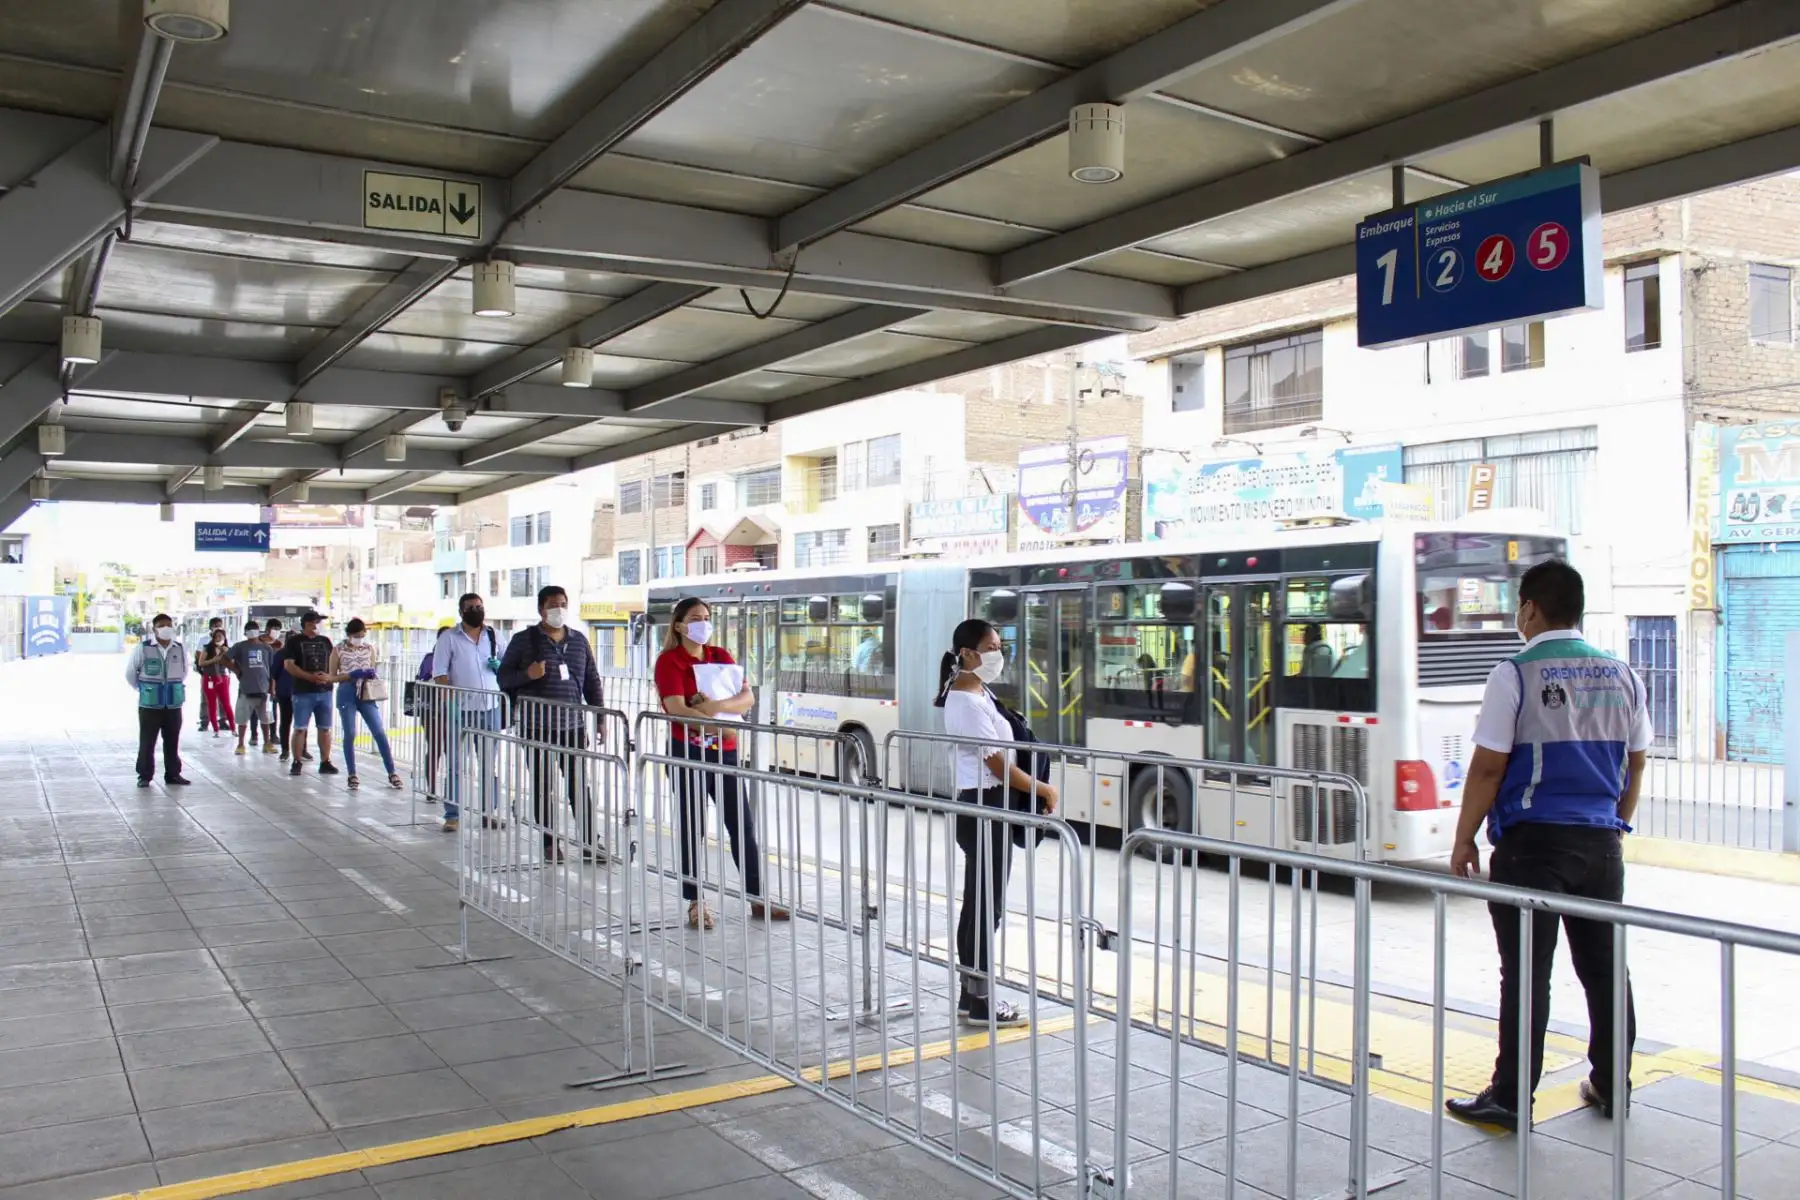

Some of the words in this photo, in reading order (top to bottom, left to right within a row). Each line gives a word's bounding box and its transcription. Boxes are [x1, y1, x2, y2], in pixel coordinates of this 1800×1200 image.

[369, 192, 441, 214] SALIDA
[1435, 202, 1464, 217] Hacia
[1467, 199, 1478, 210] el
[1479, 192, 1497, 206] Sur
[1360, 216, 1414, 240] Embarque
[1425, 219, 1461, 236] Servicios
[1425, 232, 1461, 248] Expresos
[1436, 250, 1457, 287] 2
[1483, 240, 1504, 274] 4
[1537, 228, 1558, 265] 5
[1376, 248, 1398, 306] 1
[1189, 503, 1241, 524] MOVIMIENTO
[1243, 498, 1293, 520] MISIONERO
[197, 528, 227, 536] SALIDA
[233, 528, 249, 536] Exit
[1540, 667, 1619, 681] ORIENTADOR
